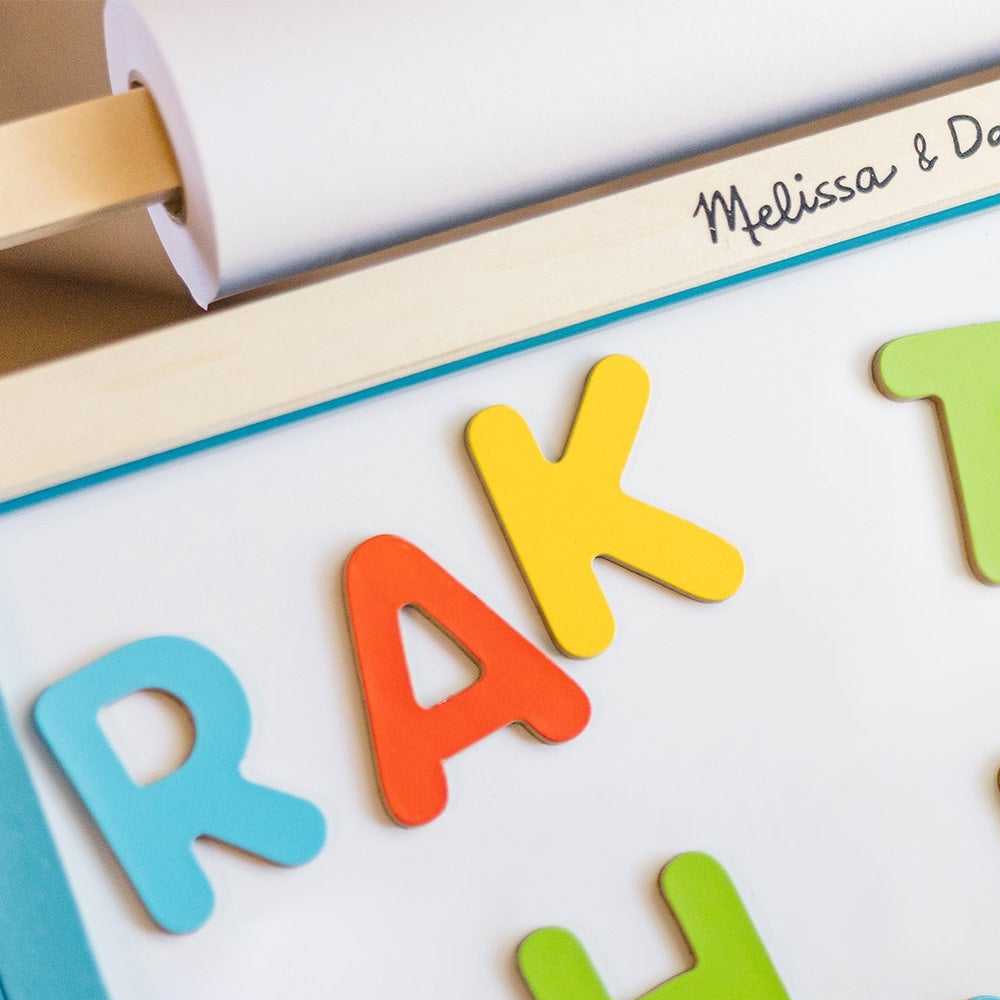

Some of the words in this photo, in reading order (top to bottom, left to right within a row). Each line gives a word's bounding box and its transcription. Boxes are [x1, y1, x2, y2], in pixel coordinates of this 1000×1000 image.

[693, 165, 898, 247] Melissa
[913, 132, 939, 172] &
[465, 353, 745, 659] K
[32, 634, 328, 935] R
[341, 533, 592, 827] A
